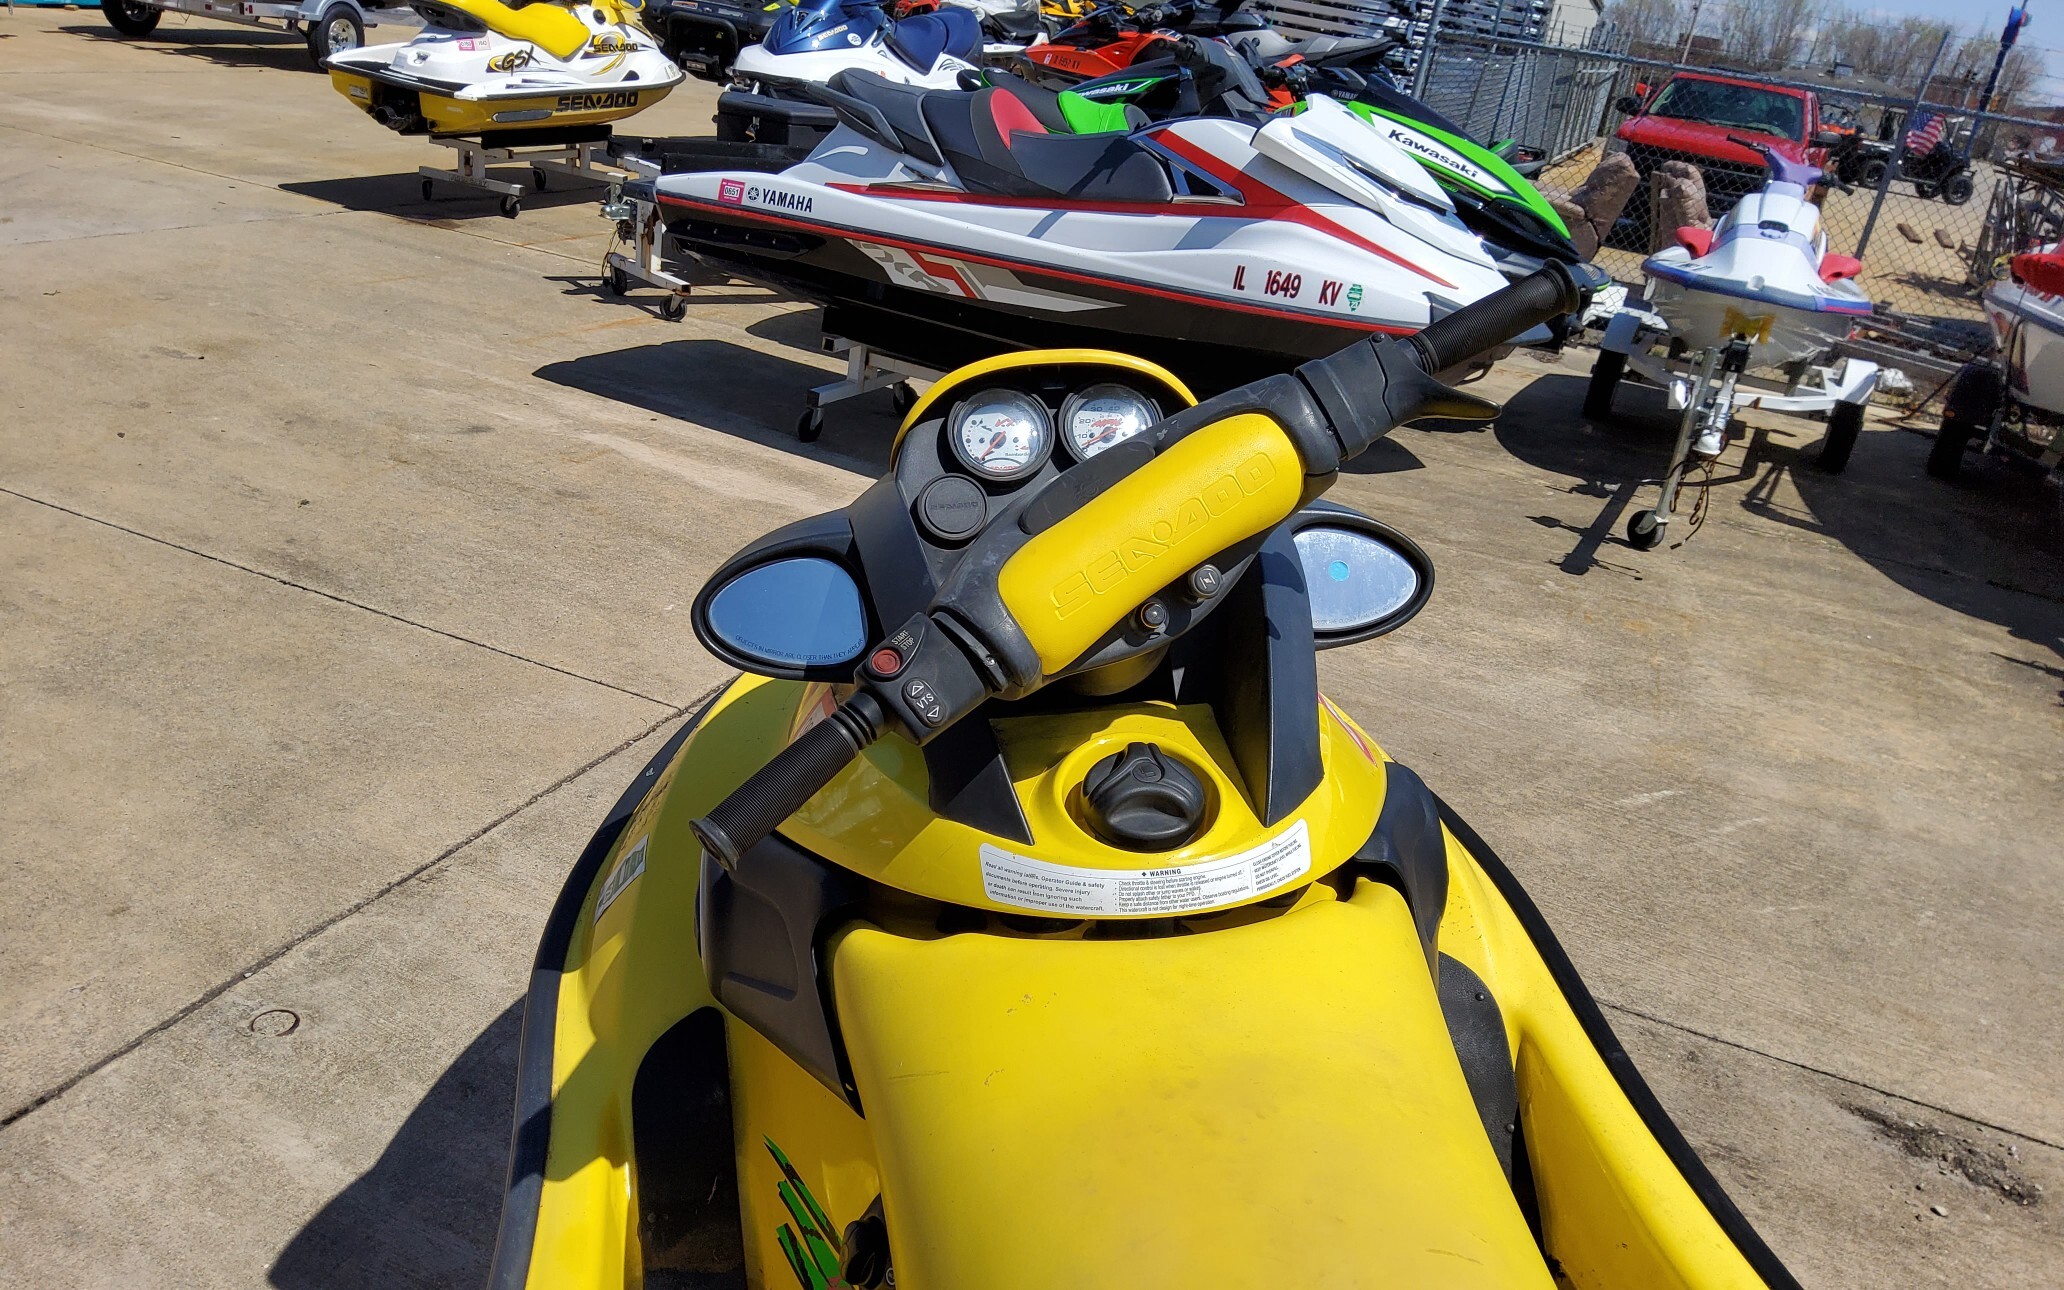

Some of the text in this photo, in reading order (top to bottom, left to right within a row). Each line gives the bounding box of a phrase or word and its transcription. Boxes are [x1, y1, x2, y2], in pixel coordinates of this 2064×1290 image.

[502, 45, 541, 77] GSX
[1388, 129, 1479, 178] Kawasaki
[762, 188, 813, 213] YAMAHA
[1232, 265, 1343, 306] IL 1649 KV
[891, 630, 910, 645] START
[900, 636, 915, 650] STOP
[916, 693, 934, 709] VTS
[985, 861, 997, 869] Read
[1004, 867, 1024, 878] warning
[1041, 876, 1064, 885] Operator
[1066, 878, 1081, 886] Guide
[985, 872, 1011, 883] documents
[1012, 877, 1028, 886] before
[1149, 868, 1182, 877] WARNING
[989, 889, 1017, 901] information
[1024, 897, 1048, 907] improper
[993, 882, 1007, 890] death
[1017, 888, 1032, 896] result
[1032, 889, 1045, 898] from
[1046, 893, 1068, 902] ignoring
